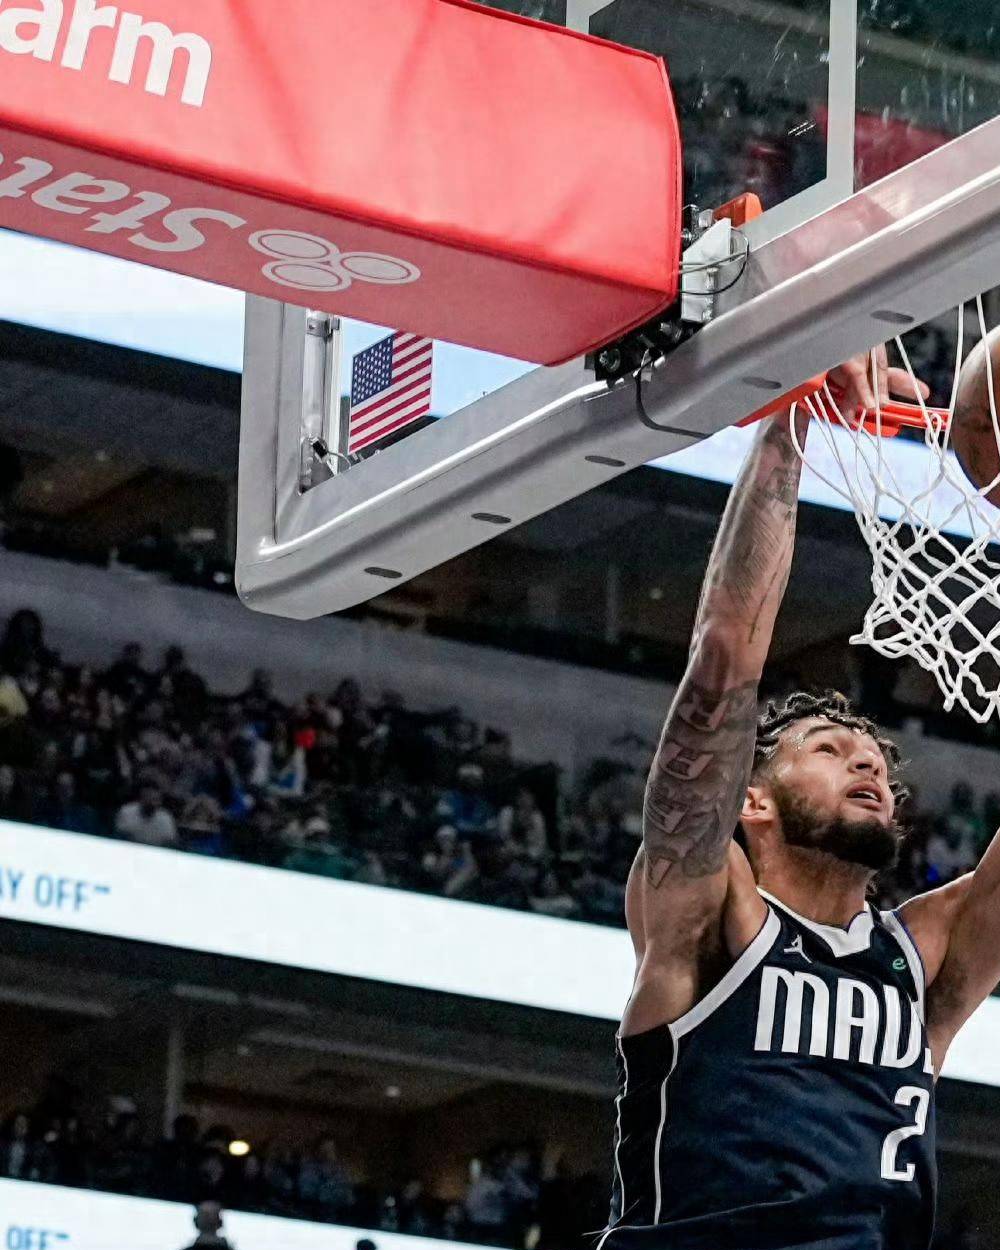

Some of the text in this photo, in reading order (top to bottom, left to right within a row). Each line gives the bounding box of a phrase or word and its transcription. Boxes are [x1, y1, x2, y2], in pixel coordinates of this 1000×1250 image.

[0, 153, 247, 252] Stat
[753, 965, 935, 1076] MAV
[880, 1085, 931, 1182] 2
